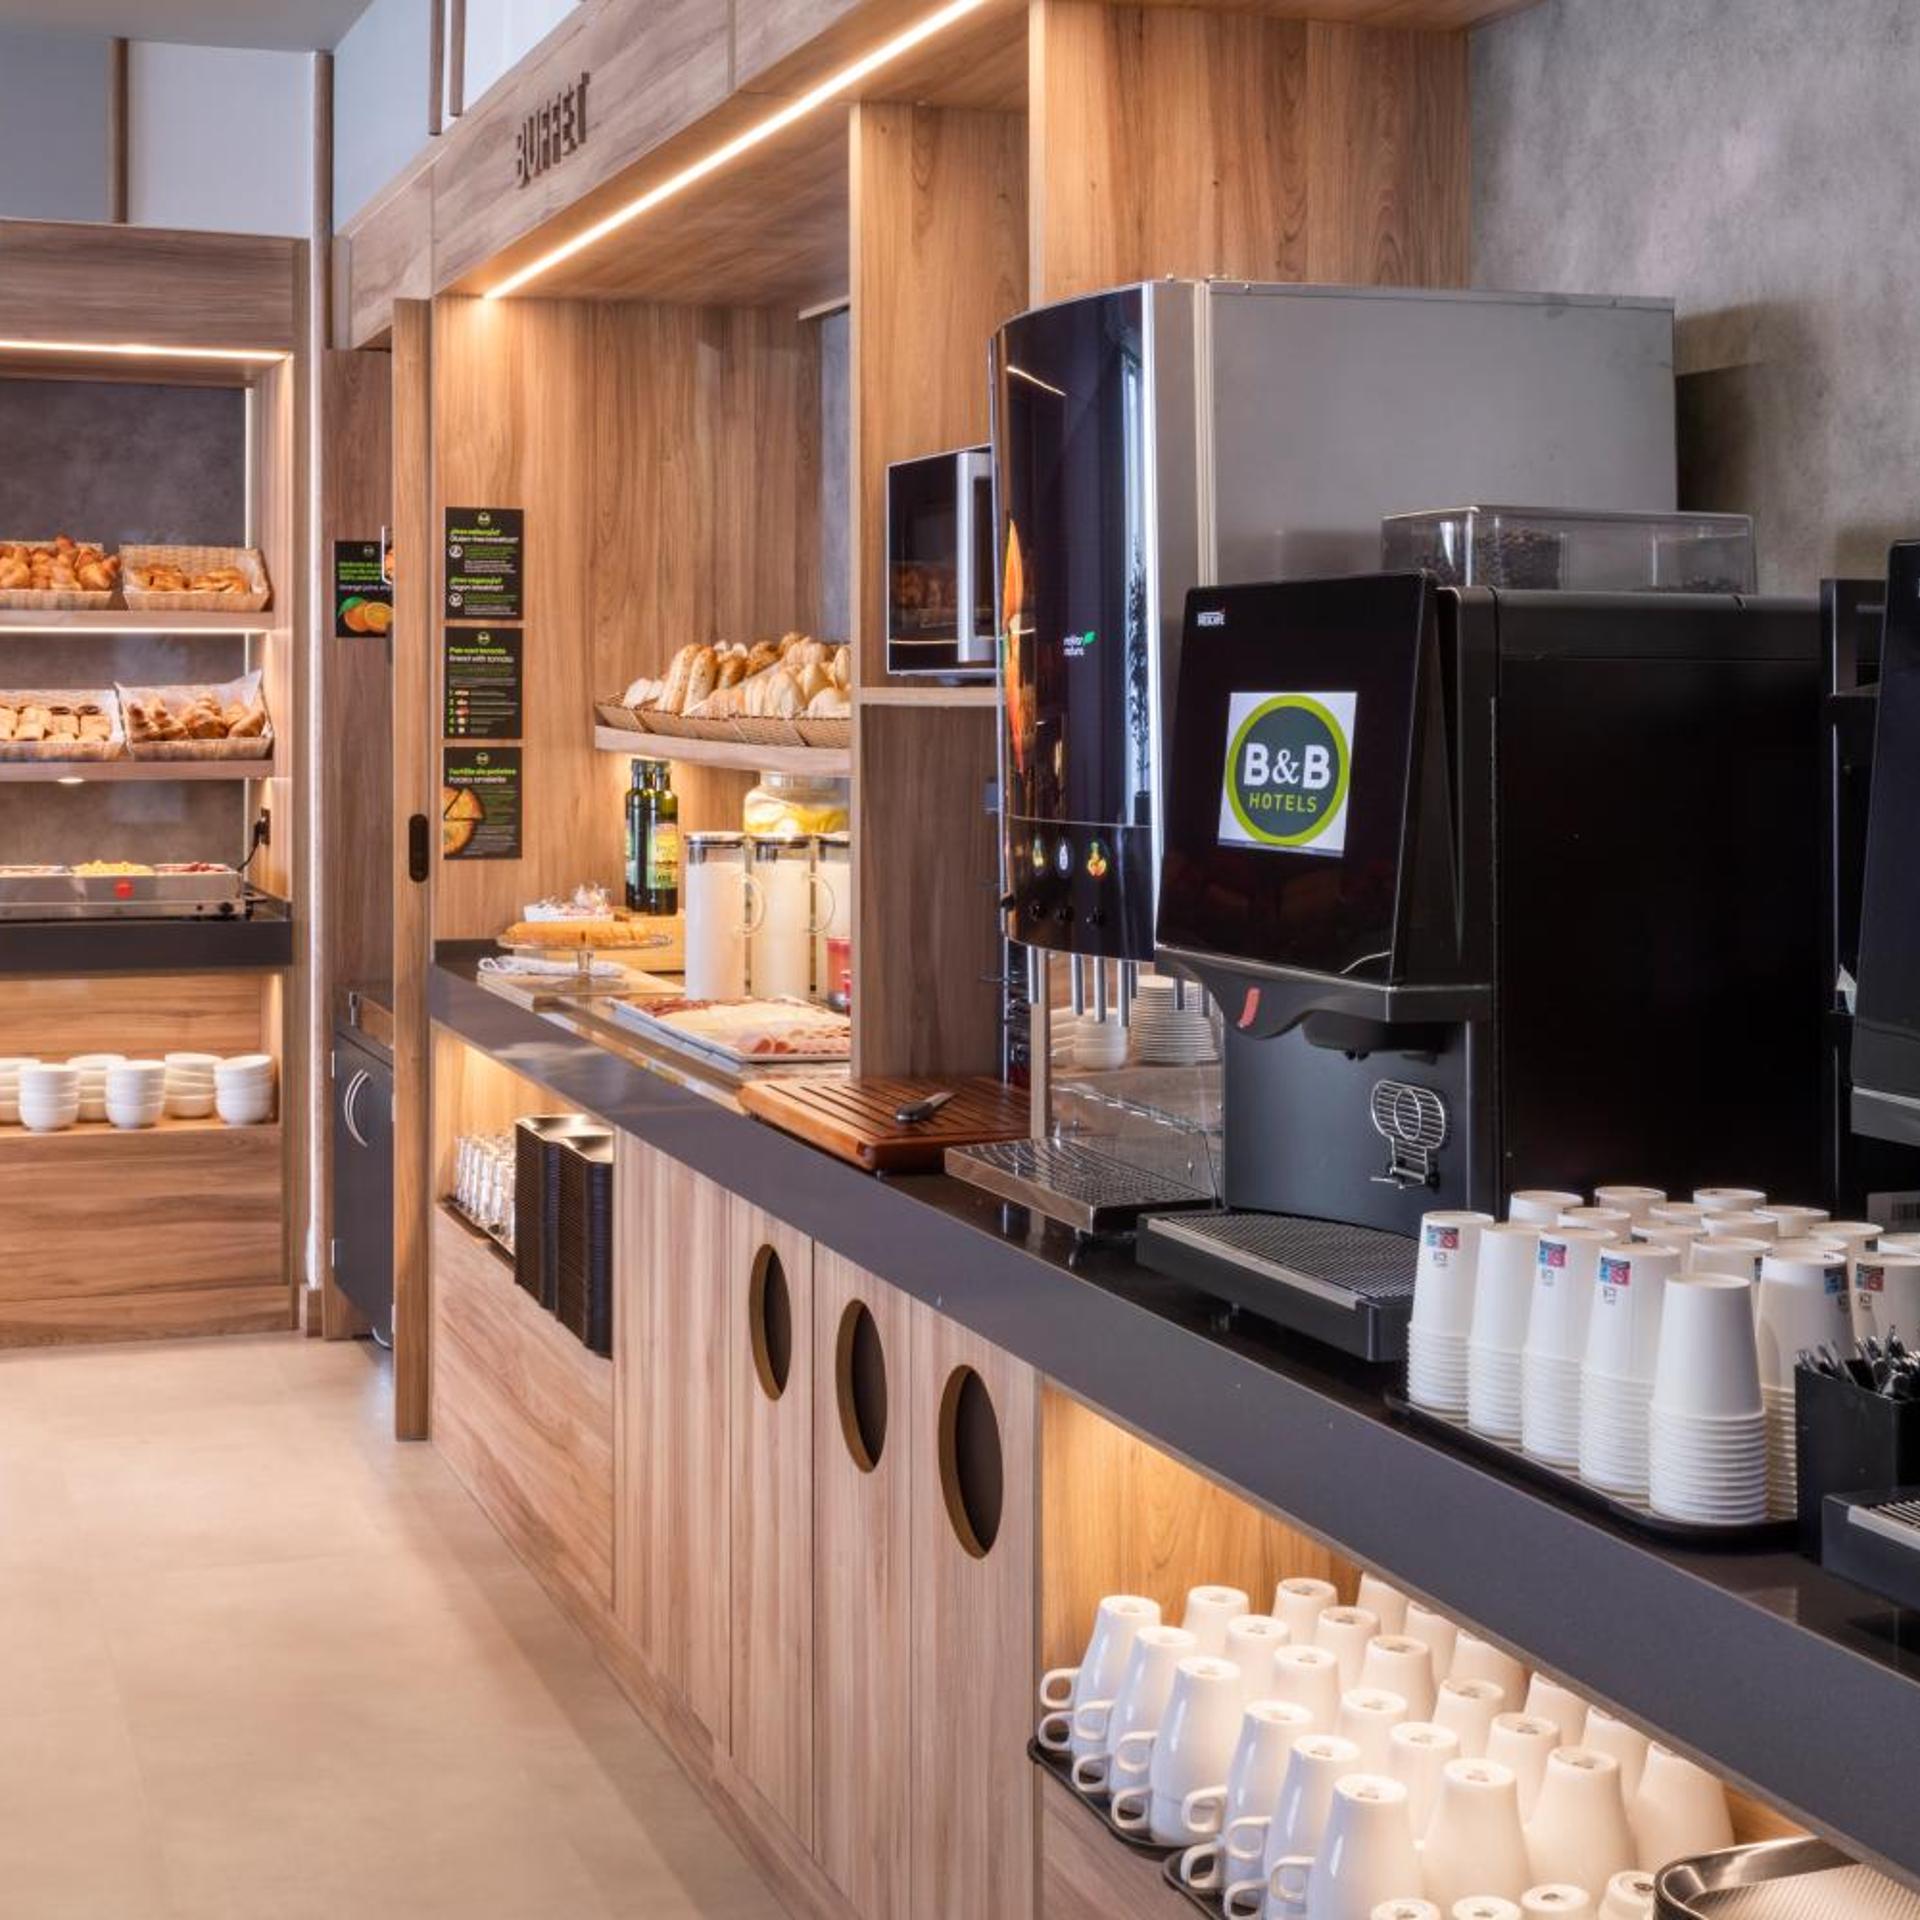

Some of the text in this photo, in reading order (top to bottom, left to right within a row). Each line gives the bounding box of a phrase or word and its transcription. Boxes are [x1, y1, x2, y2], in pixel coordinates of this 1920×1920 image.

[518, 73, 590, 189] BUFFET
[1243, 743, 1332, 790] B&B
[1249, 792, 1318, 814] HOTELS
